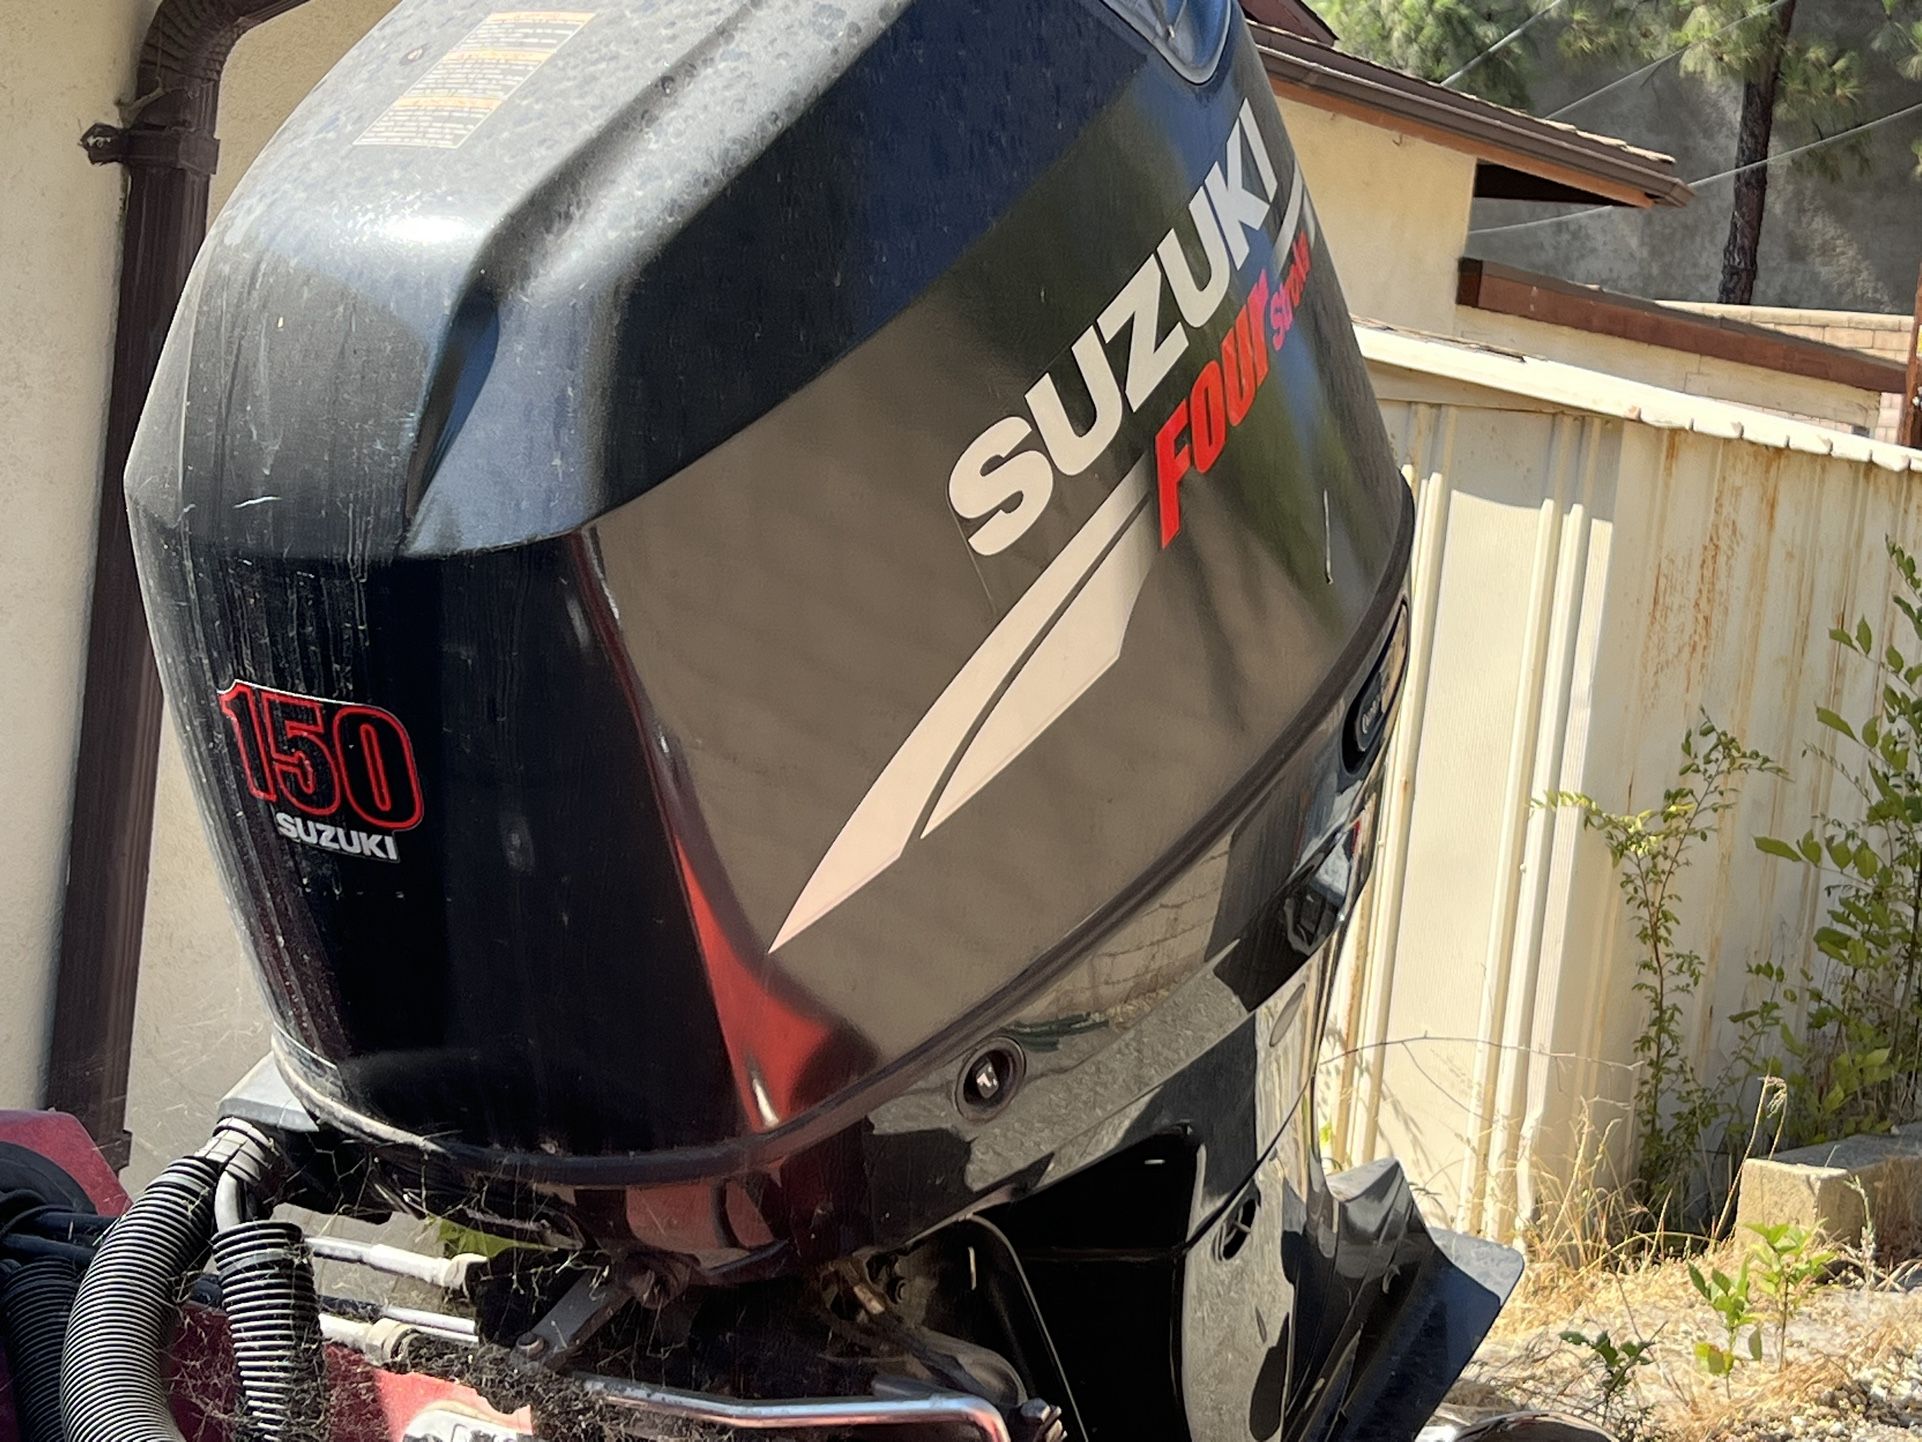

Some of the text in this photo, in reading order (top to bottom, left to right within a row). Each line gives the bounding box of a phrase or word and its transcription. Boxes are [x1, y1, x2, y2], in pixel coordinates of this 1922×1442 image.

[949, 97, 1278, 556] SUZUKI
[219, 682, 424, 829] 150
[276, 812, 399, 860] SUZUKI
